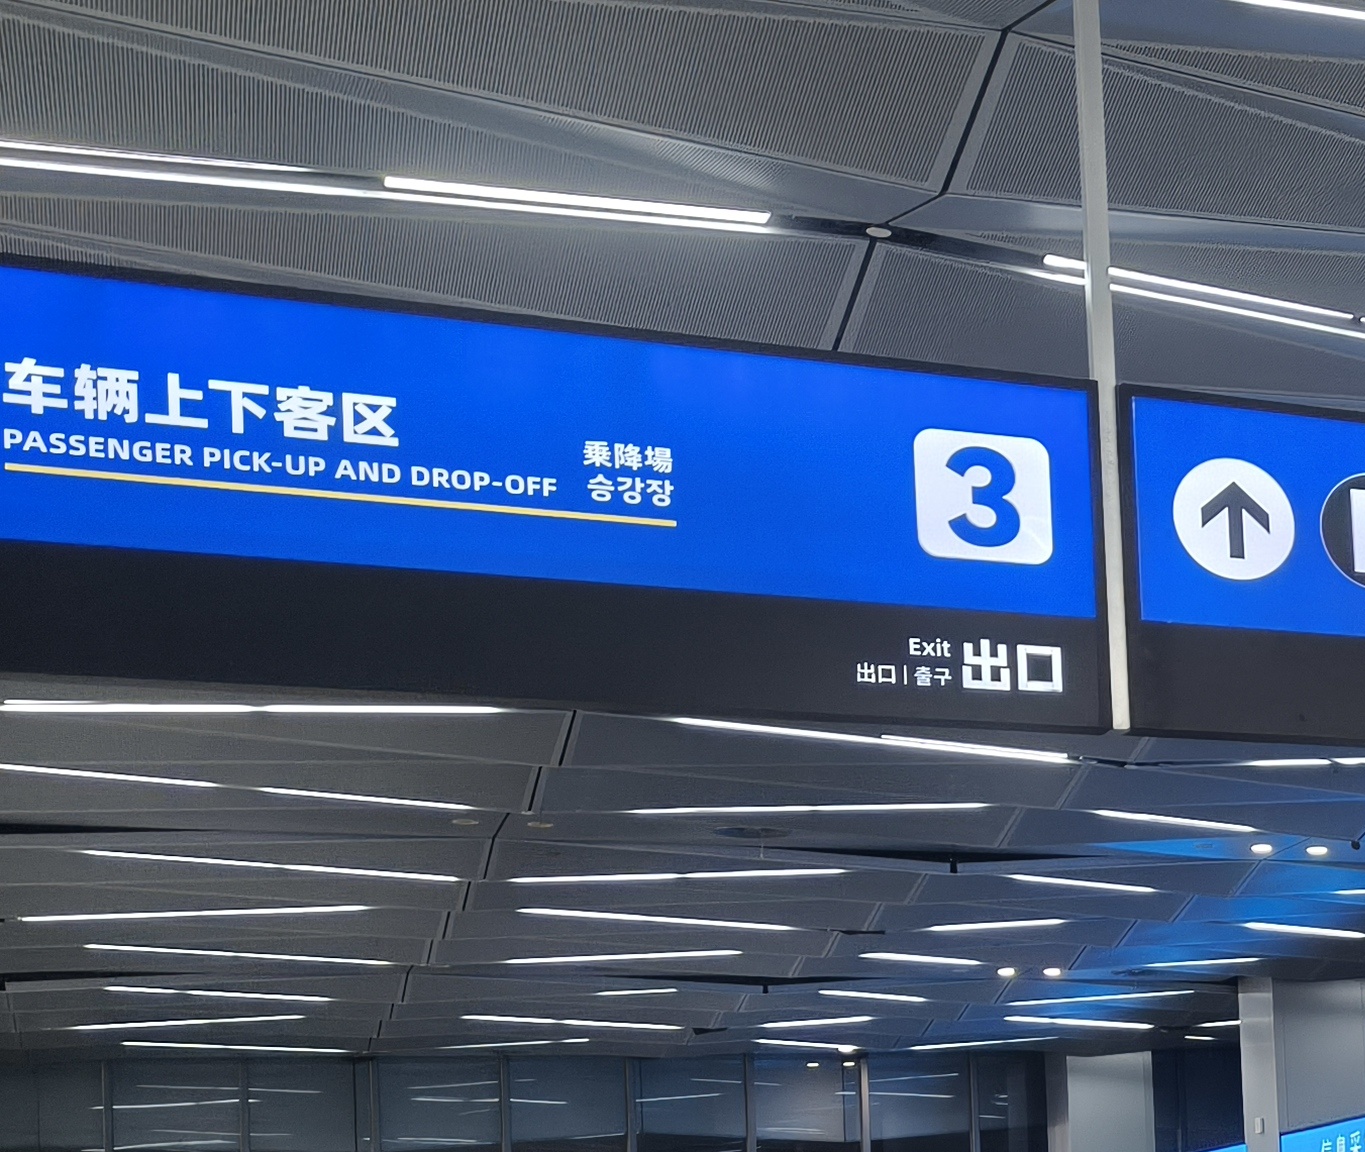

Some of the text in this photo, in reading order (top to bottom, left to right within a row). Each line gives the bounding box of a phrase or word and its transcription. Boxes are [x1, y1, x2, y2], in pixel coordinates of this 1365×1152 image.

[3, 357, 399, 447] 车辆上下客区
[4, 428, 557, 497] PASSENGER PICK-UP AND DROP-OFF
[587, 474, 675, 507] 승강장
[946, 446, 1021, 547] 3
[908, 637, 951, 657] Exit
[962, 639, 1063, 692] 出口
[856, 662, 896, 684] 出口
[914, 666, 952, 687] 출구
